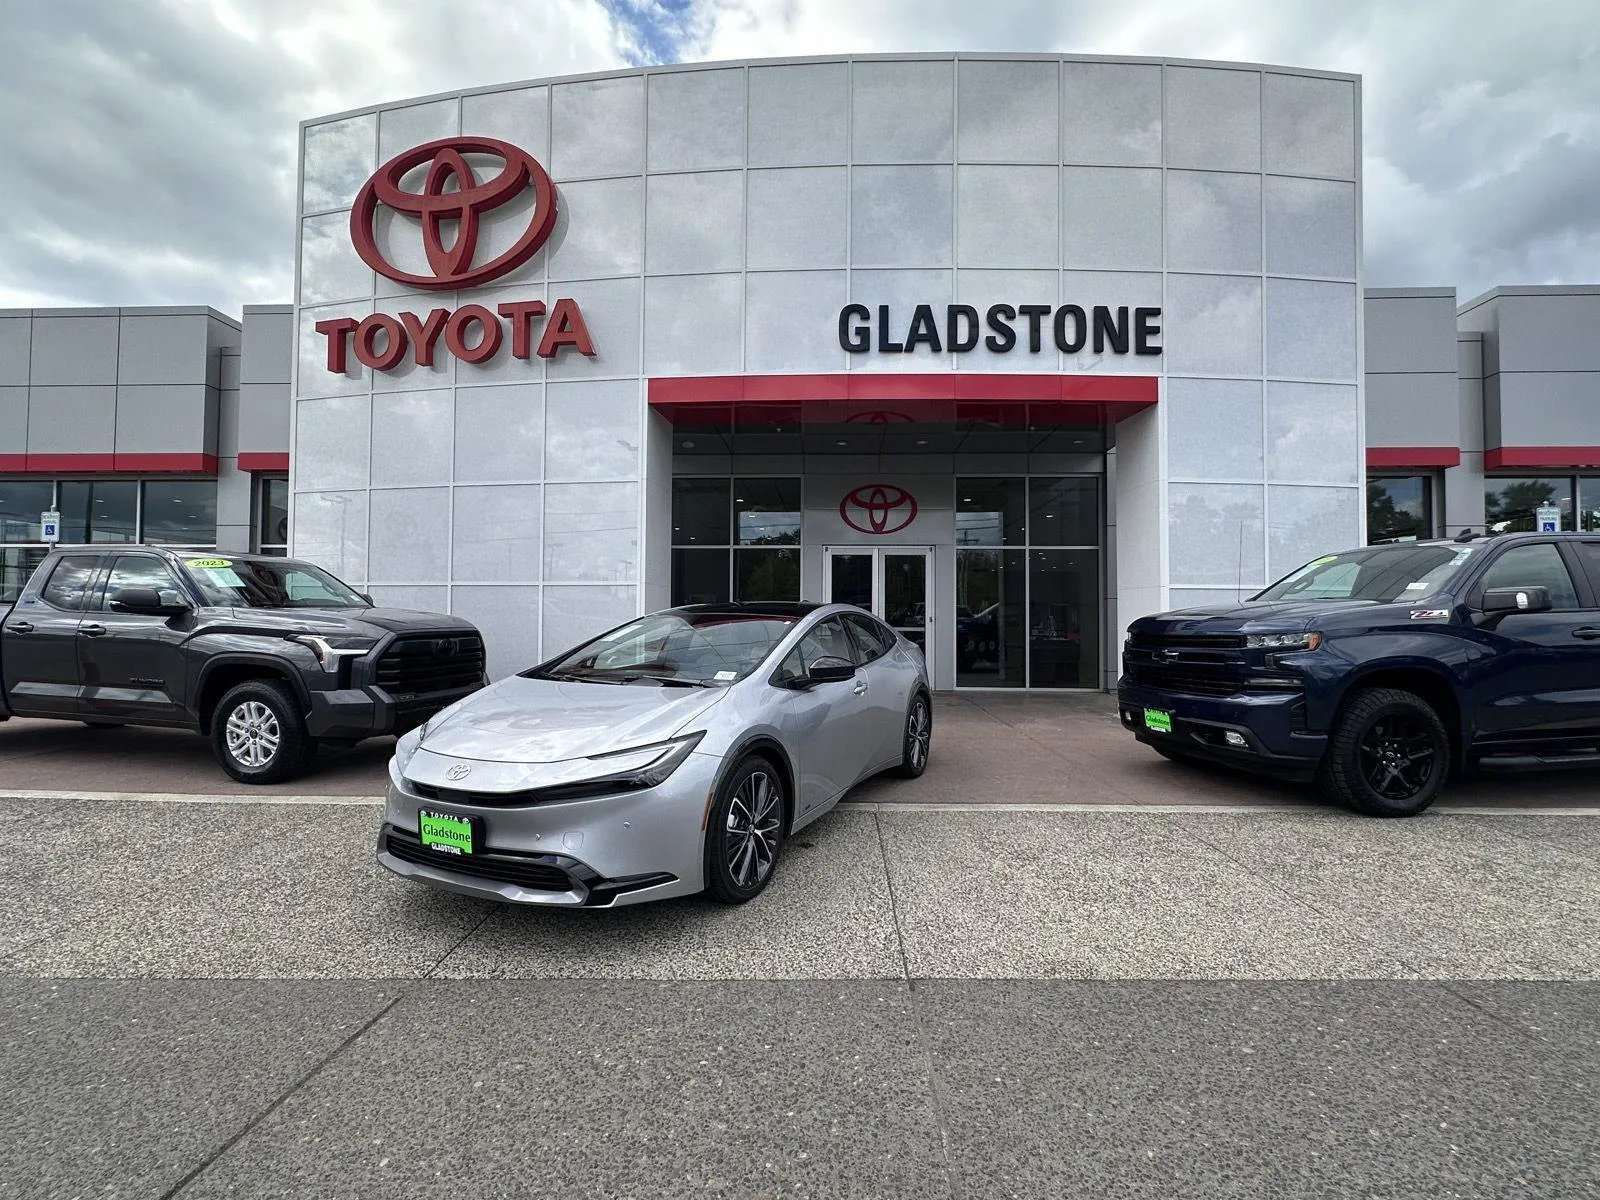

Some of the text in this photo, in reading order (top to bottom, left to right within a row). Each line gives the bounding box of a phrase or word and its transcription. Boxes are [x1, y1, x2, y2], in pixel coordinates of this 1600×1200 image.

[315, 298, 597, 374] TOYOTA
[838, 303, 1163, 355] GLADSTONE
[430, 811, 459, 822] TOYOTA
[422, 823, 471, 843] Gladstone
[431, 842, 462, 856] GLADSTONE
